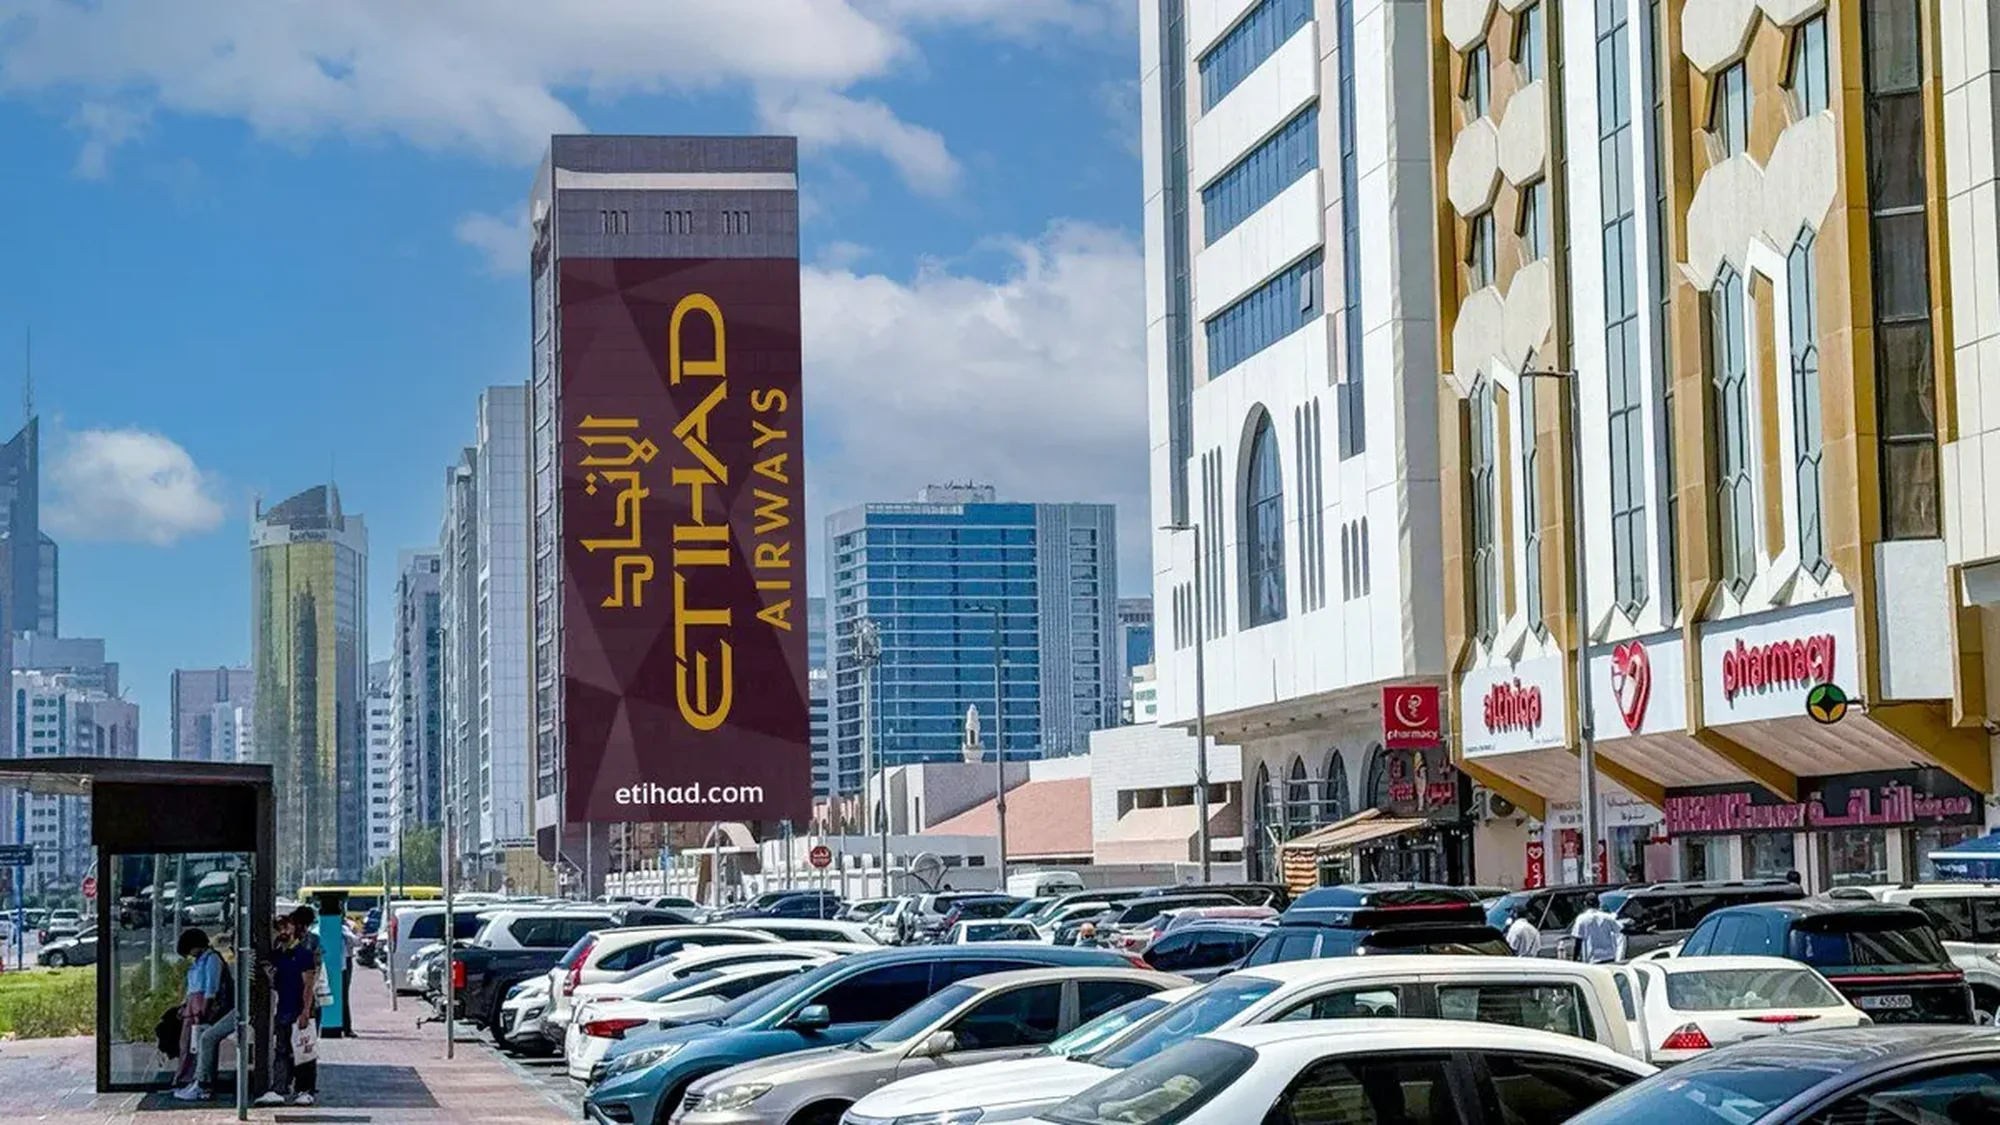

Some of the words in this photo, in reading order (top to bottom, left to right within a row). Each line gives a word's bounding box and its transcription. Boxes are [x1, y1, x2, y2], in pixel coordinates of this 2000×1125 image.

[669, 292, 733, 731] ETIHAD
[751, 388, 792, 631] AIRWAYS
[1723, 634, 1836, 705] pharmacy
[1387, 729, 1438, 741] pharmacy
[614, 782, 765, 806] etihad.com
